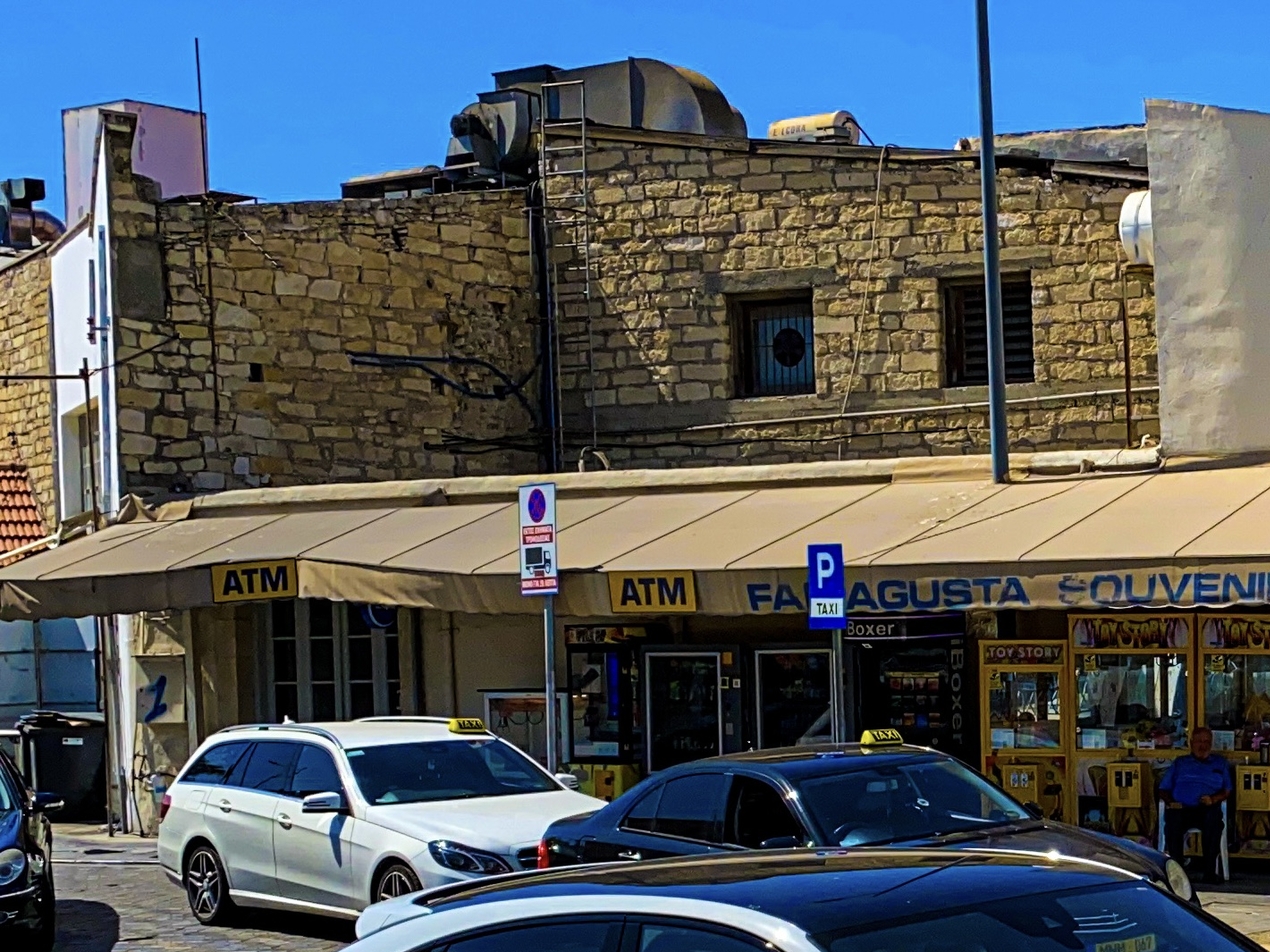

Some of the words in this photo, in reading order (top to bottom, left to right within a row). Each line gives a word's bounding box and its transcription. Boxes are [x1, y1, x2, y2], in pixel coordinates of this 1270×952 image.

[223, 566, 288, 595] ATM
[817, 552, 834, 589] P
[621, 577, 687, 606] ATM
[747, 577, 1031, 612] FAAGUSTA
[817, 602, 838, 615] TAXI
[847, 621, 895, 635] Boxer
[1092, 618, 1119, 646] TOY
[1121, 619, 1169, 647] STORY
[1222, 618, 1249, 646] TOY
[989, 647, 1014, 658] TOY
[1018, 647, 1061, 658] STORY
[951, 639, 963, 744] iBoxer
[458, 720, 483, 729] TAXI
[873, 730, 901, 740] TAXI
